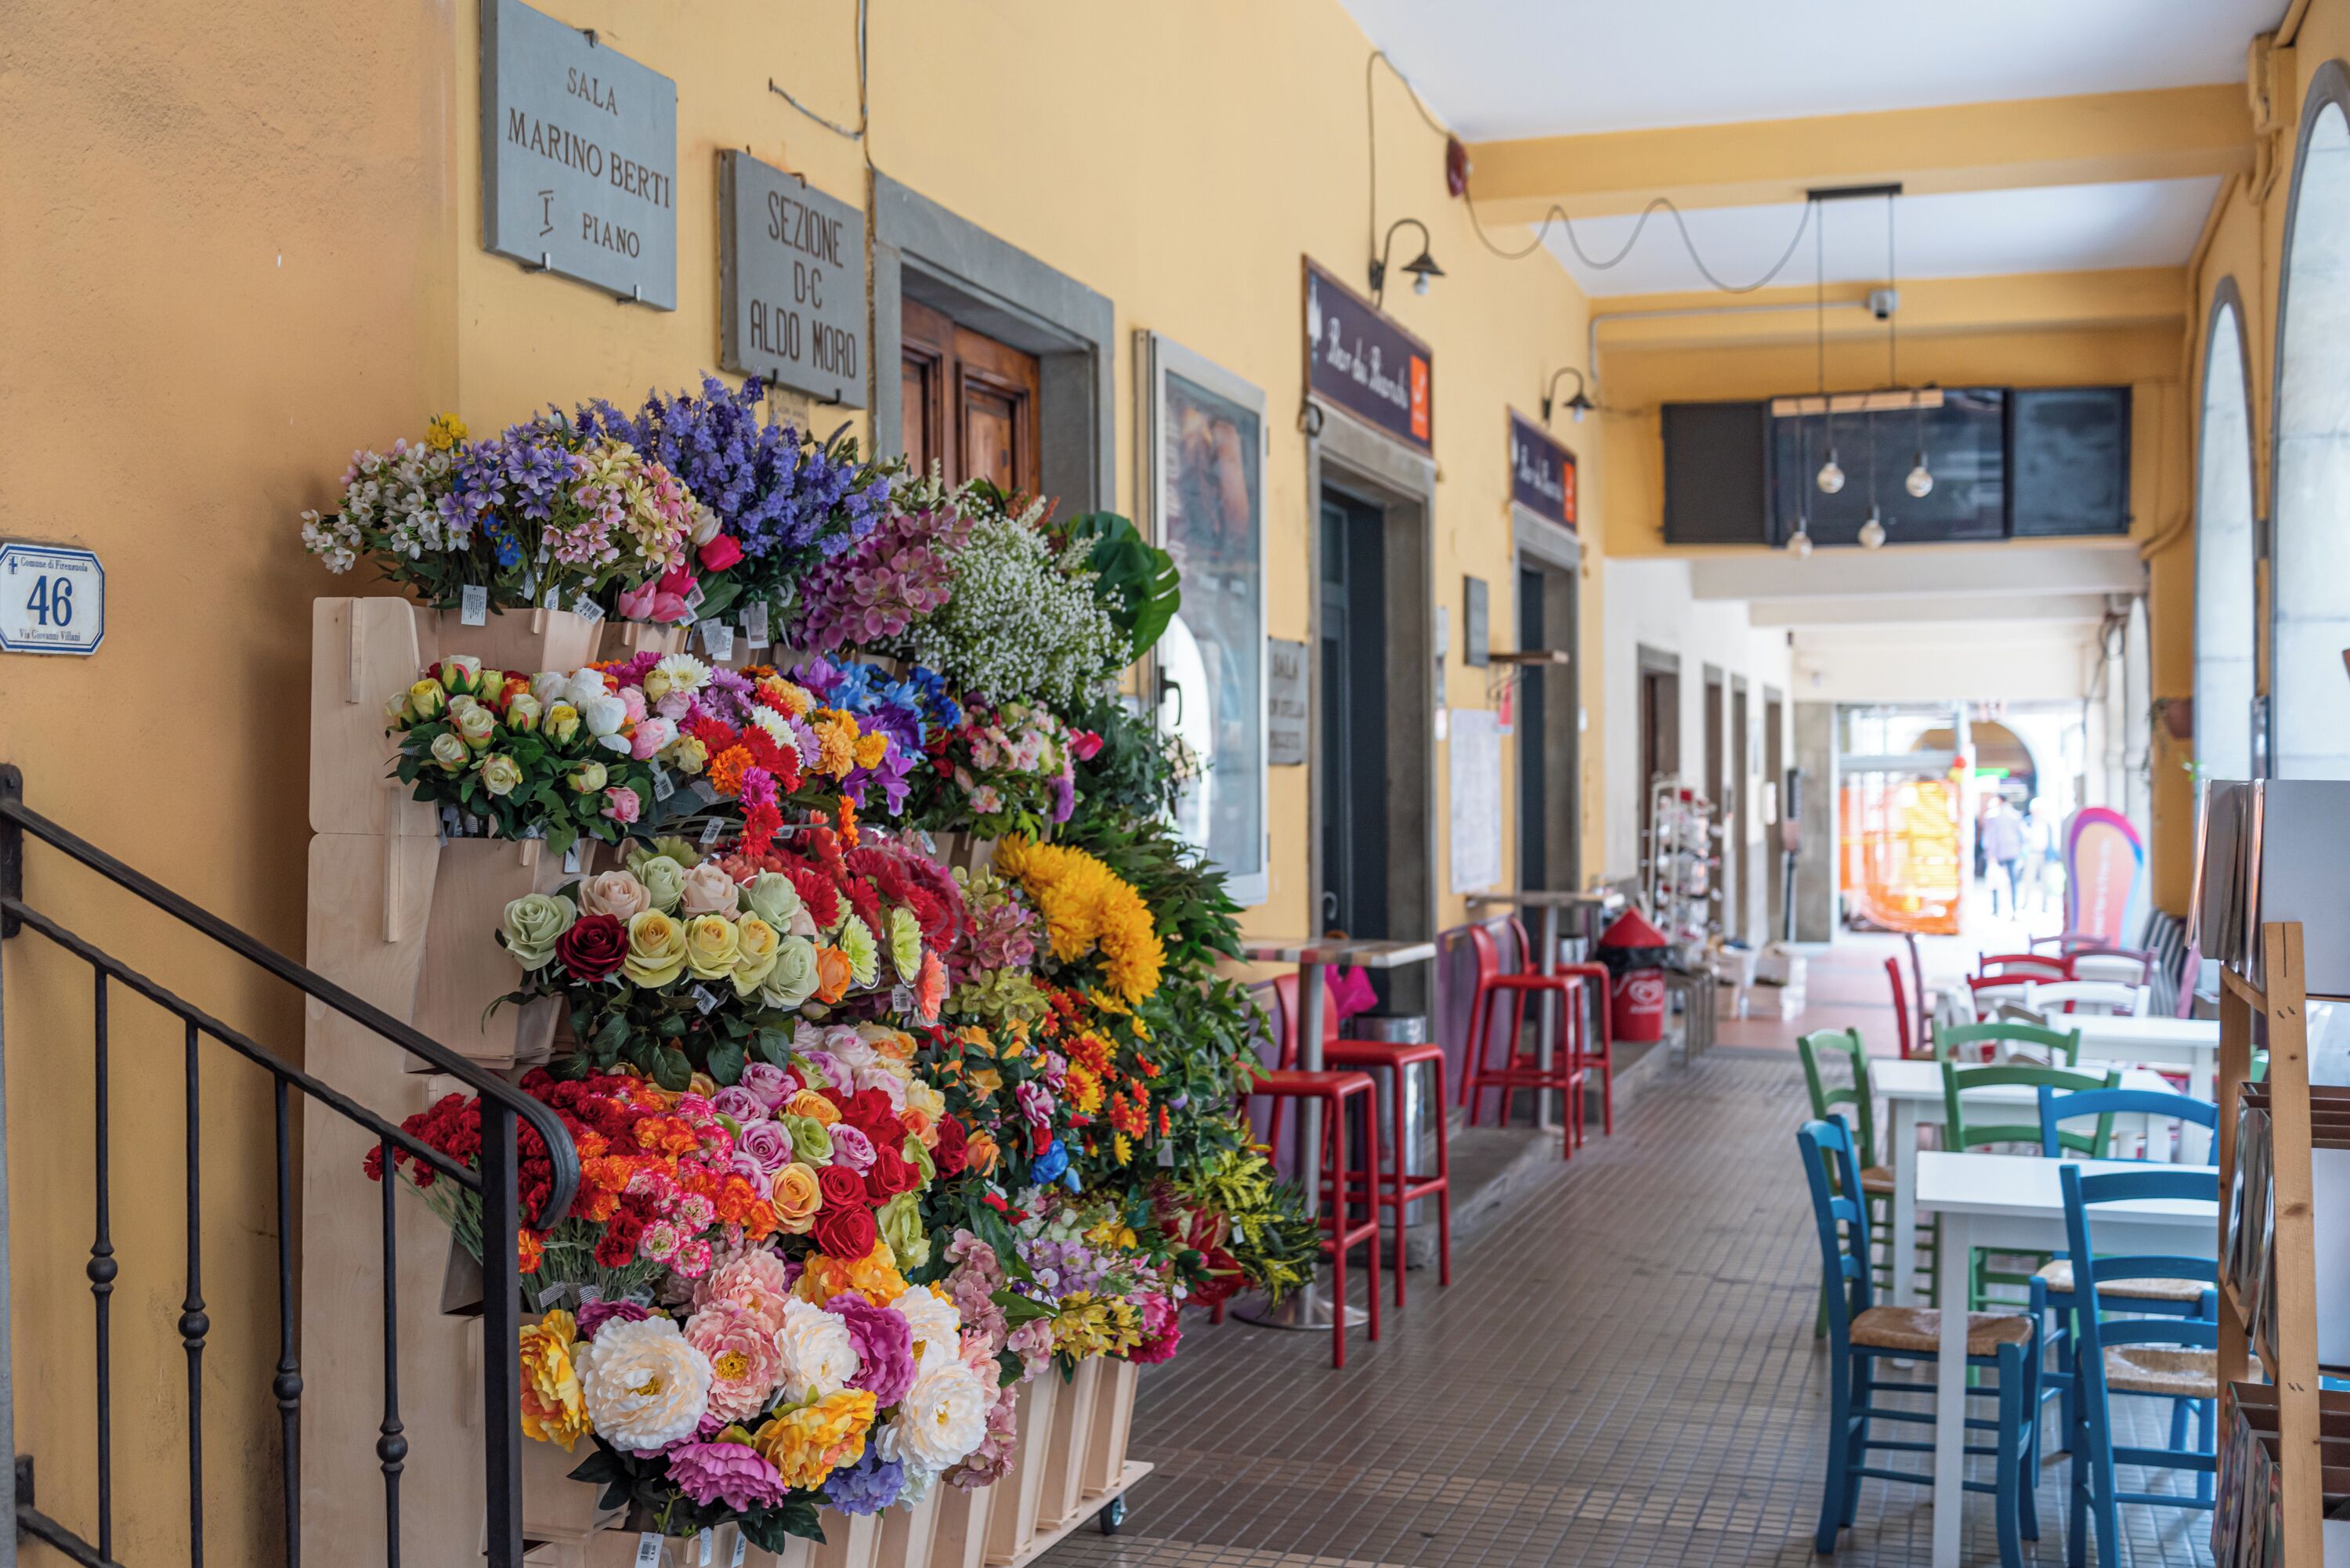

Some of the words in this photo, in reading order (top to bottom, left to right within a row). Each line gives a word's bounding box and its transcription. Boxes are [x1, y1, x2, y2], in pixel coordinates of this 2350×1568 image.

[566, 67, 618, 116] SALA
[508, 107, 603, 178] MARINO
[610, 152, 671, 208] BERTI
[582, 212, 641, 258] PIANO
[767, 190, 844, 268] SEZIONE
[750, 298, 801, 362] ALDO
[812, 320, 857, 379] MORO
[20, 556, 46, 568] Comune
[48, 558, 54, 569] di
[55, 559, 89, 573] Firenzuola
[27, 575, 73, 627] 46
[20, 628, 30, 639] Via
[31, 629, 59, 641] Giovanni
[60, 630, 81, 641] Villani
